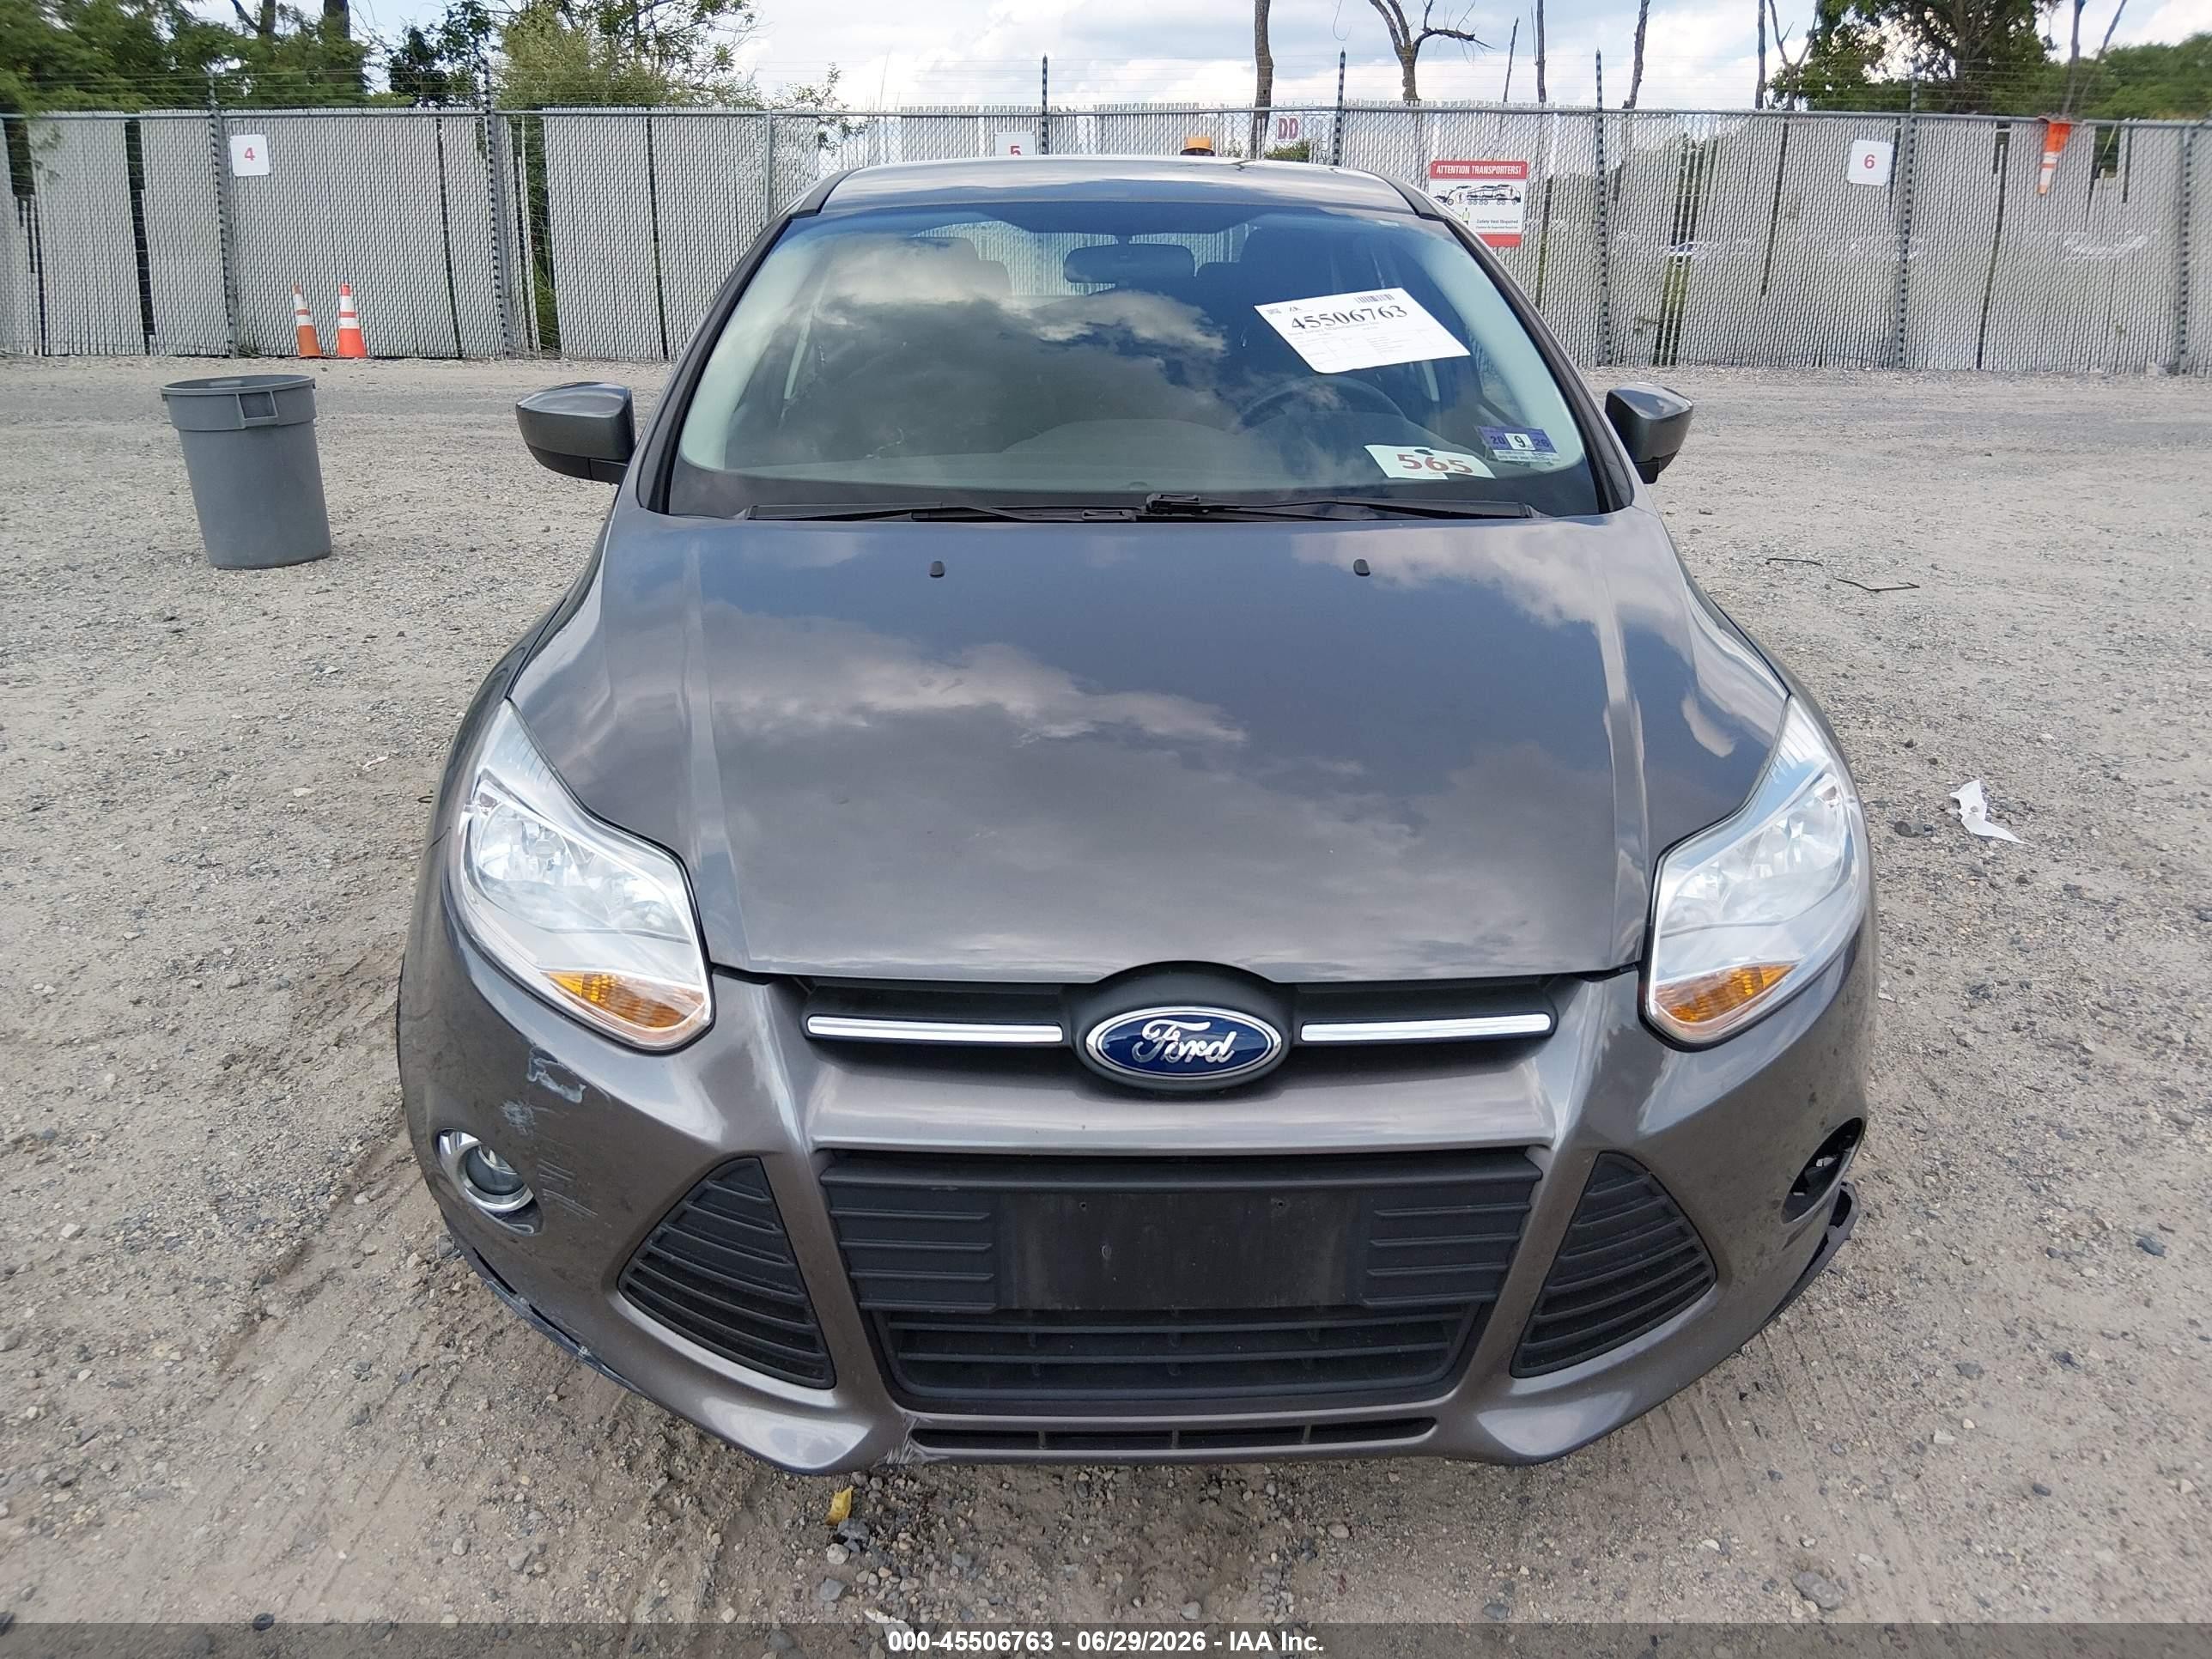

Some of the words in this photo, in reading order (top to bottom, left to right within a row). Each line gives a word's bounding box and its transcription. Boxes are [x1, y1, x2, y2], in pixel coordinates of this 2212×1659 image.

[1278, 118, 1299, 139] DD
[244, 147, 256, 161] 4
[1010, 145, 1022, 156] 5
[1863, 154, 1875, 169] 6
[1436, 165, 1470, 174] ATTENTION
[1471, 165, 1522, 174] TRANSPORTERS!
[1291, 304, 1408, 330] 45506763
[1491, 435, 1506, 445] 20
[1514, 435, 1526, 448] 9
[1396, 453, 1474, 474] 565
[1132, 1018, 1237, 1064] Ford
